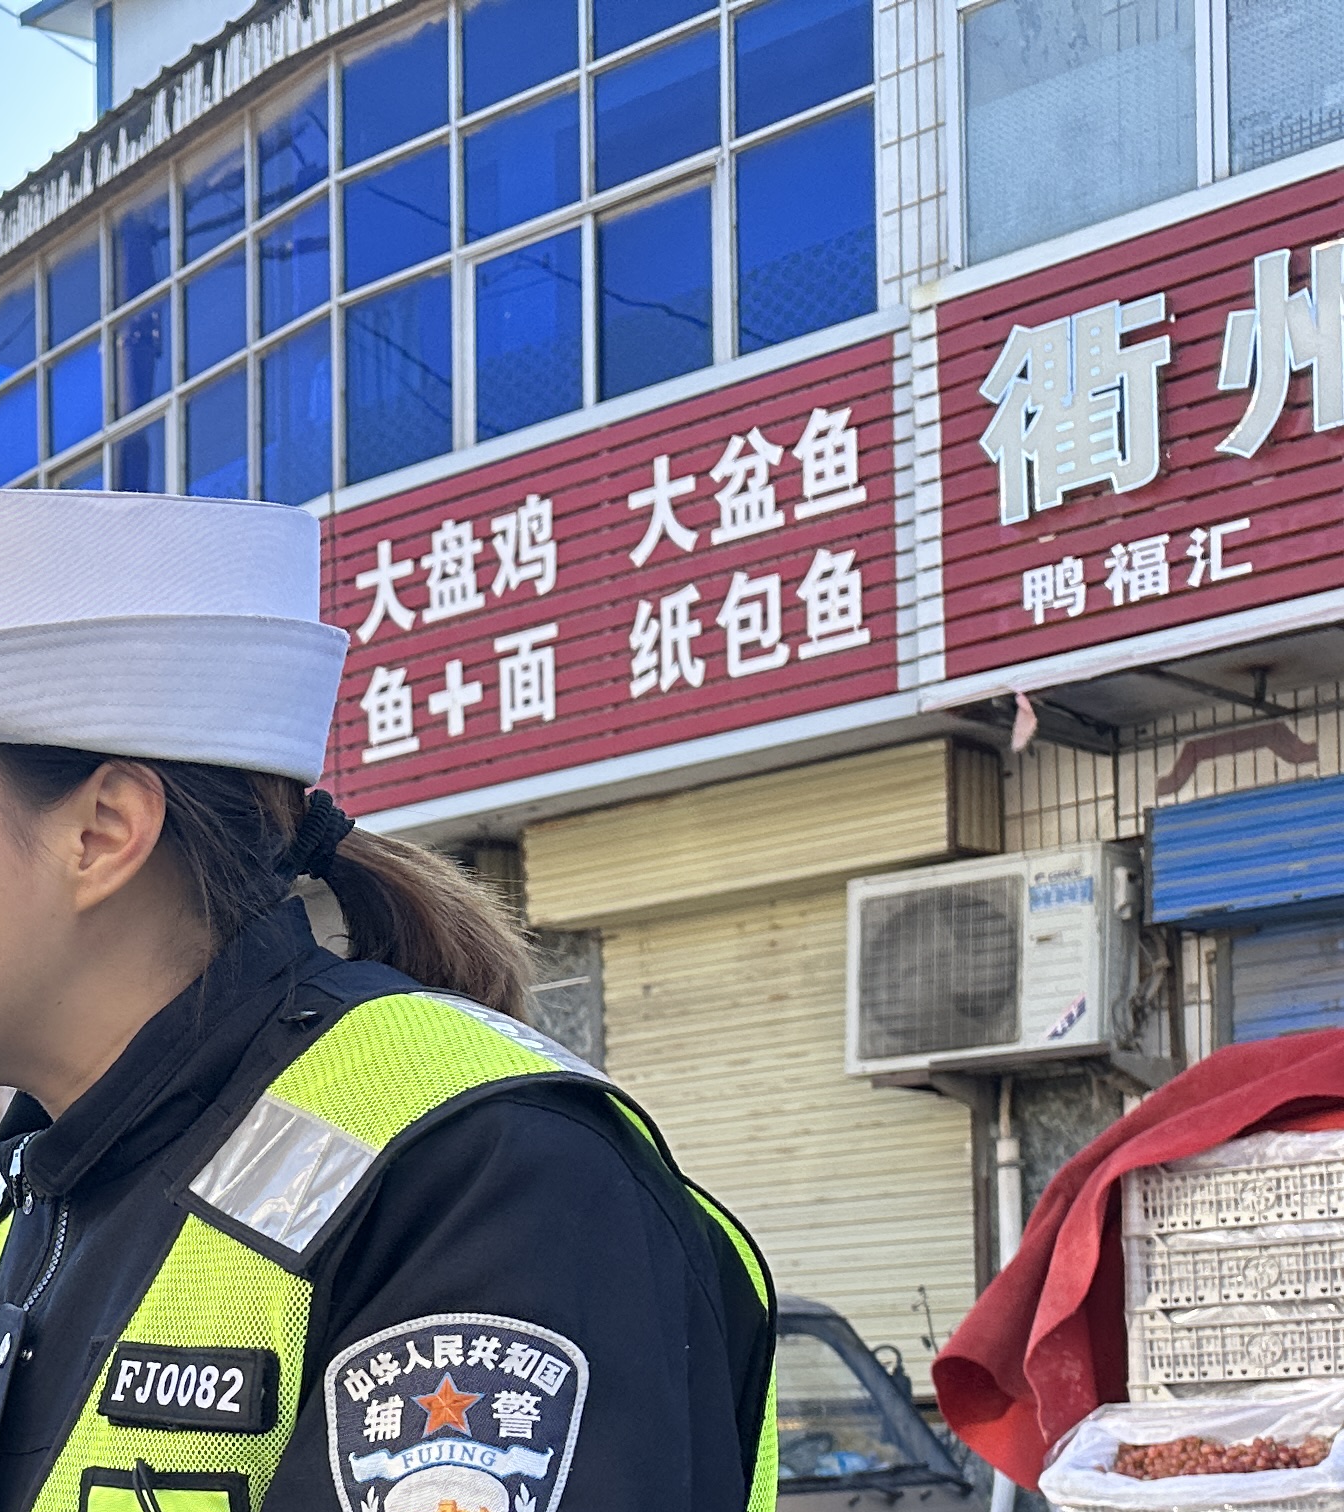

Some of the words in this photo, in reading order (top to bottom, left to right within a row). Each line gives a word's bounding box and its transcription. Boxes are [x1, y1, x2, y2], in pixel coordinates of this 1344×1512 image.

[355, 492, 559, 645] 大盘鸡
[628, 407, 867, 568] 大盆鱼
[1023, 518, 1253, 625] 鸭福汇
[629, 548, 871, 699] 纸包鱼
[111, 1359, 245, 1413] FJ0082
[343, 1334, 571, 1397] 中华人民共和国
[402, 1443, 497, 1470] FUJING
